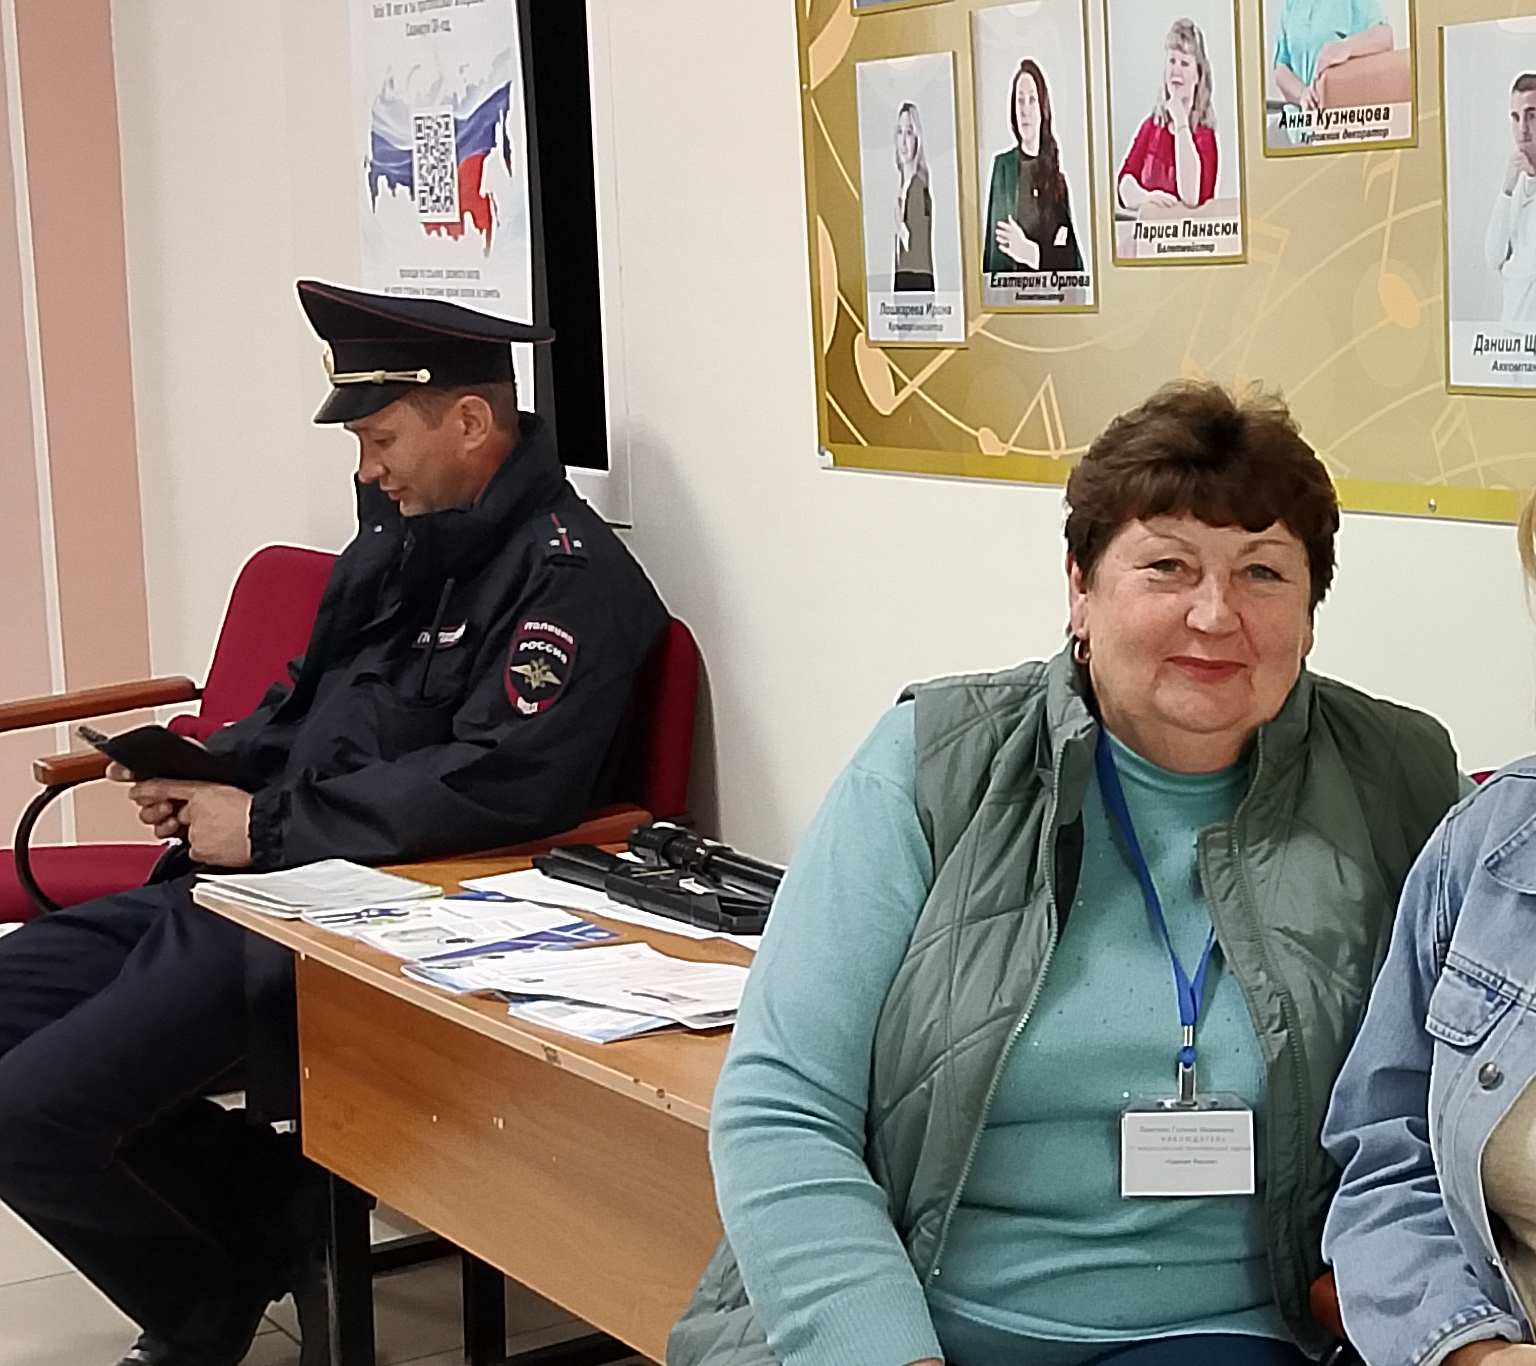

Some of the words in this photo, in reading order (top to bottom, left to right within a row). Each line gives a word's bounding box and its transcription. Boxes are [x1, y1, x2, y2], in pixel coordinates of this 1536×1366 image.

[1279, 110, 1312, 129] Анна
[1316, 106, 1390, 130] Кузнецова
[1133, 222, 1178, 243] Лариса
[1182, 220, 1238, 237] Панасюк
[990, 273, 1047, 290] Екатерина
[1050, 272, 1090, 291] Орлова
[1473, 334, 1521, 355] Даниил
